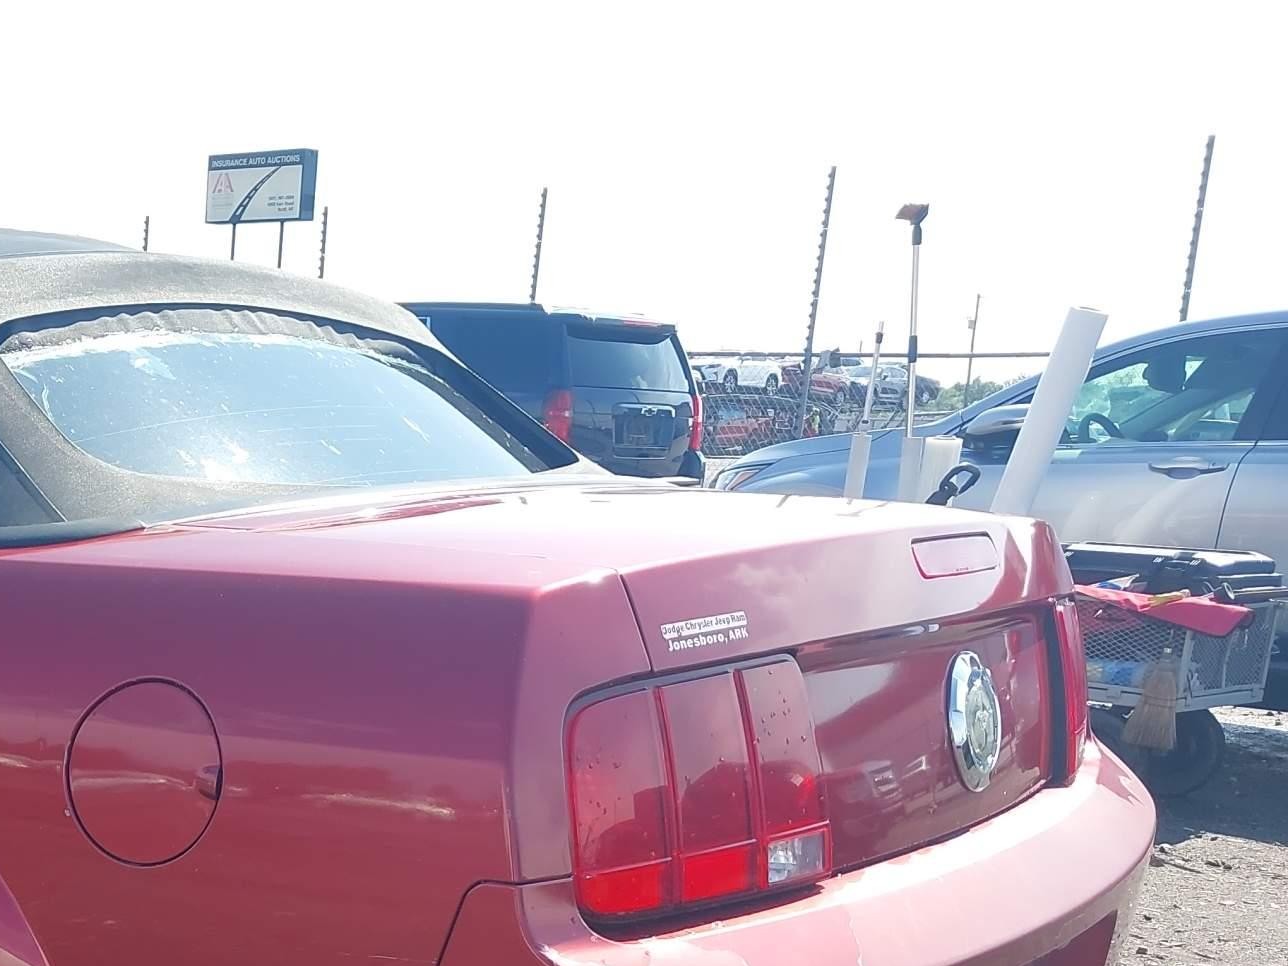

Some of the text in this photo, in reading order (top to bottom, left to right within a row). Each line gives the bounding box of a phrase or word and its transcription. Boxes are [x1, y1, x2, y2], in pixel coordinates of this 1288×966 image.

[211, 154, 300, 168] INSURANCE AUTO AUCTIONS
[668, 627, 749, 652] Jonesboro, ARK
